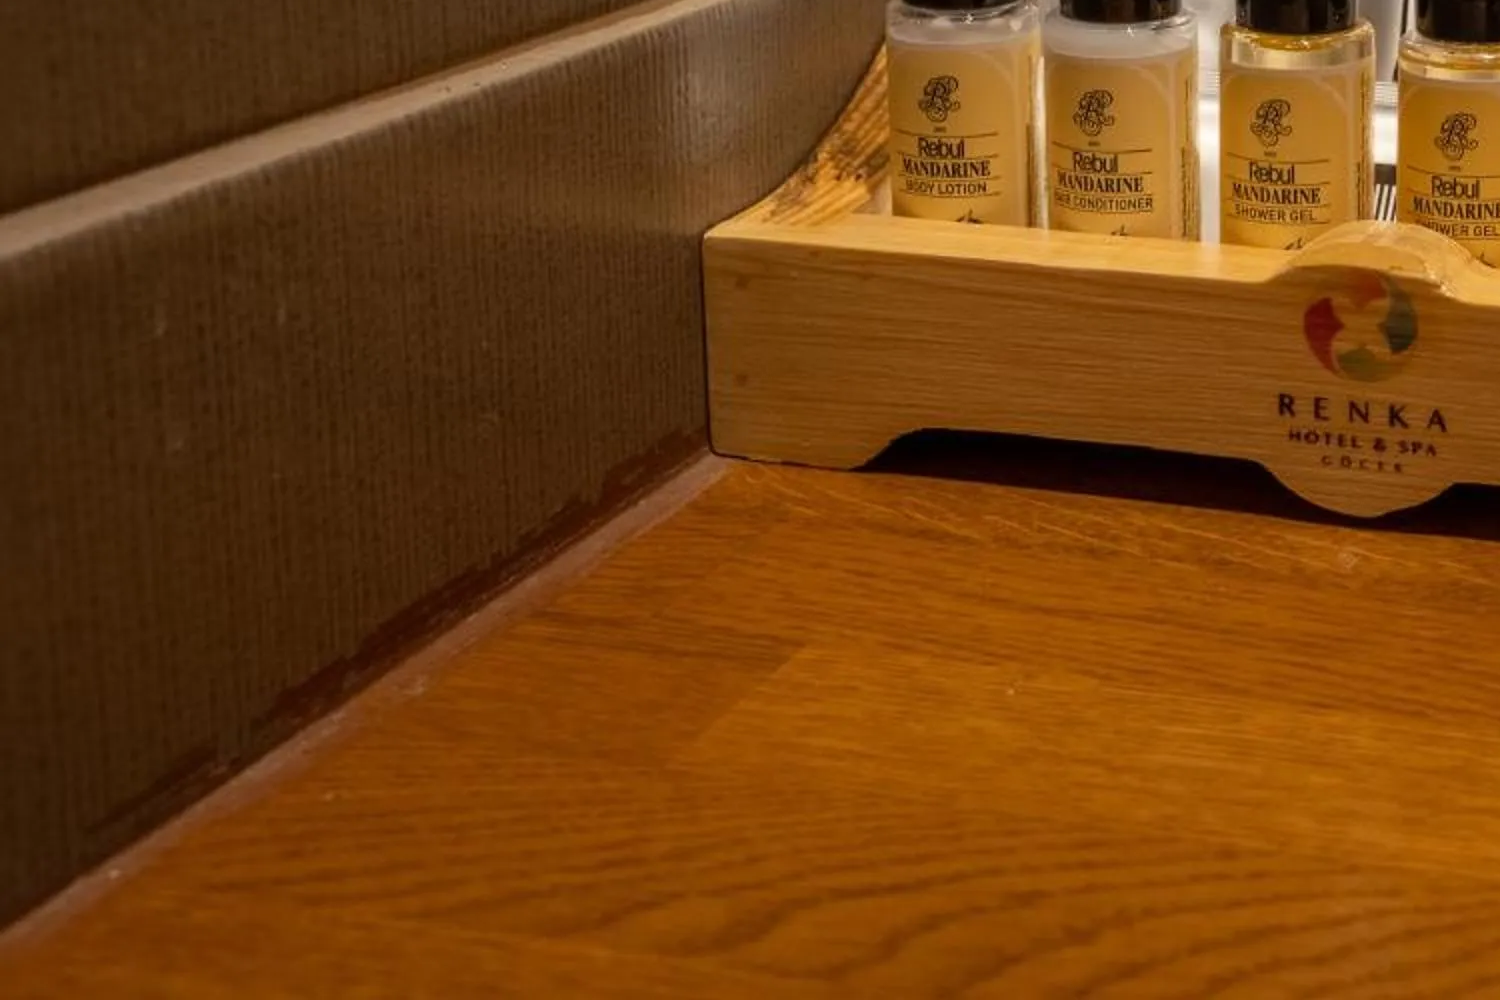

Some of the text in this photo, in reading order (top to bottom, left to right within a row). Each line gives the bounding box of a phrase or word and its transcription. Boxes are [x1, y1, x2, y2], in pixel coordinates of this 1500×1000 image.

[917, 136, 966, 159] Rebul
[903, 158, 991, 179] MANDARINE
[1072, 151, 1119, 173] Rebul
[1249, 161, 1295, 184] Rebul
[905, 180, 987, 195] BODY LOTION
[1057, 170, 1144, 193] MANDARINE
[1431, 175, 1480, 198] Rebul
[1073, 195, 1153, 211] CONDITIONER
[1232, 183, 1321, 205] MANDARINE
[1235, 204, 1317, 222] SHOWER GEL
[1277, 393, 1448, 433] RENKA
[1288, 428, 1437, 457] HOTEL & SPA
